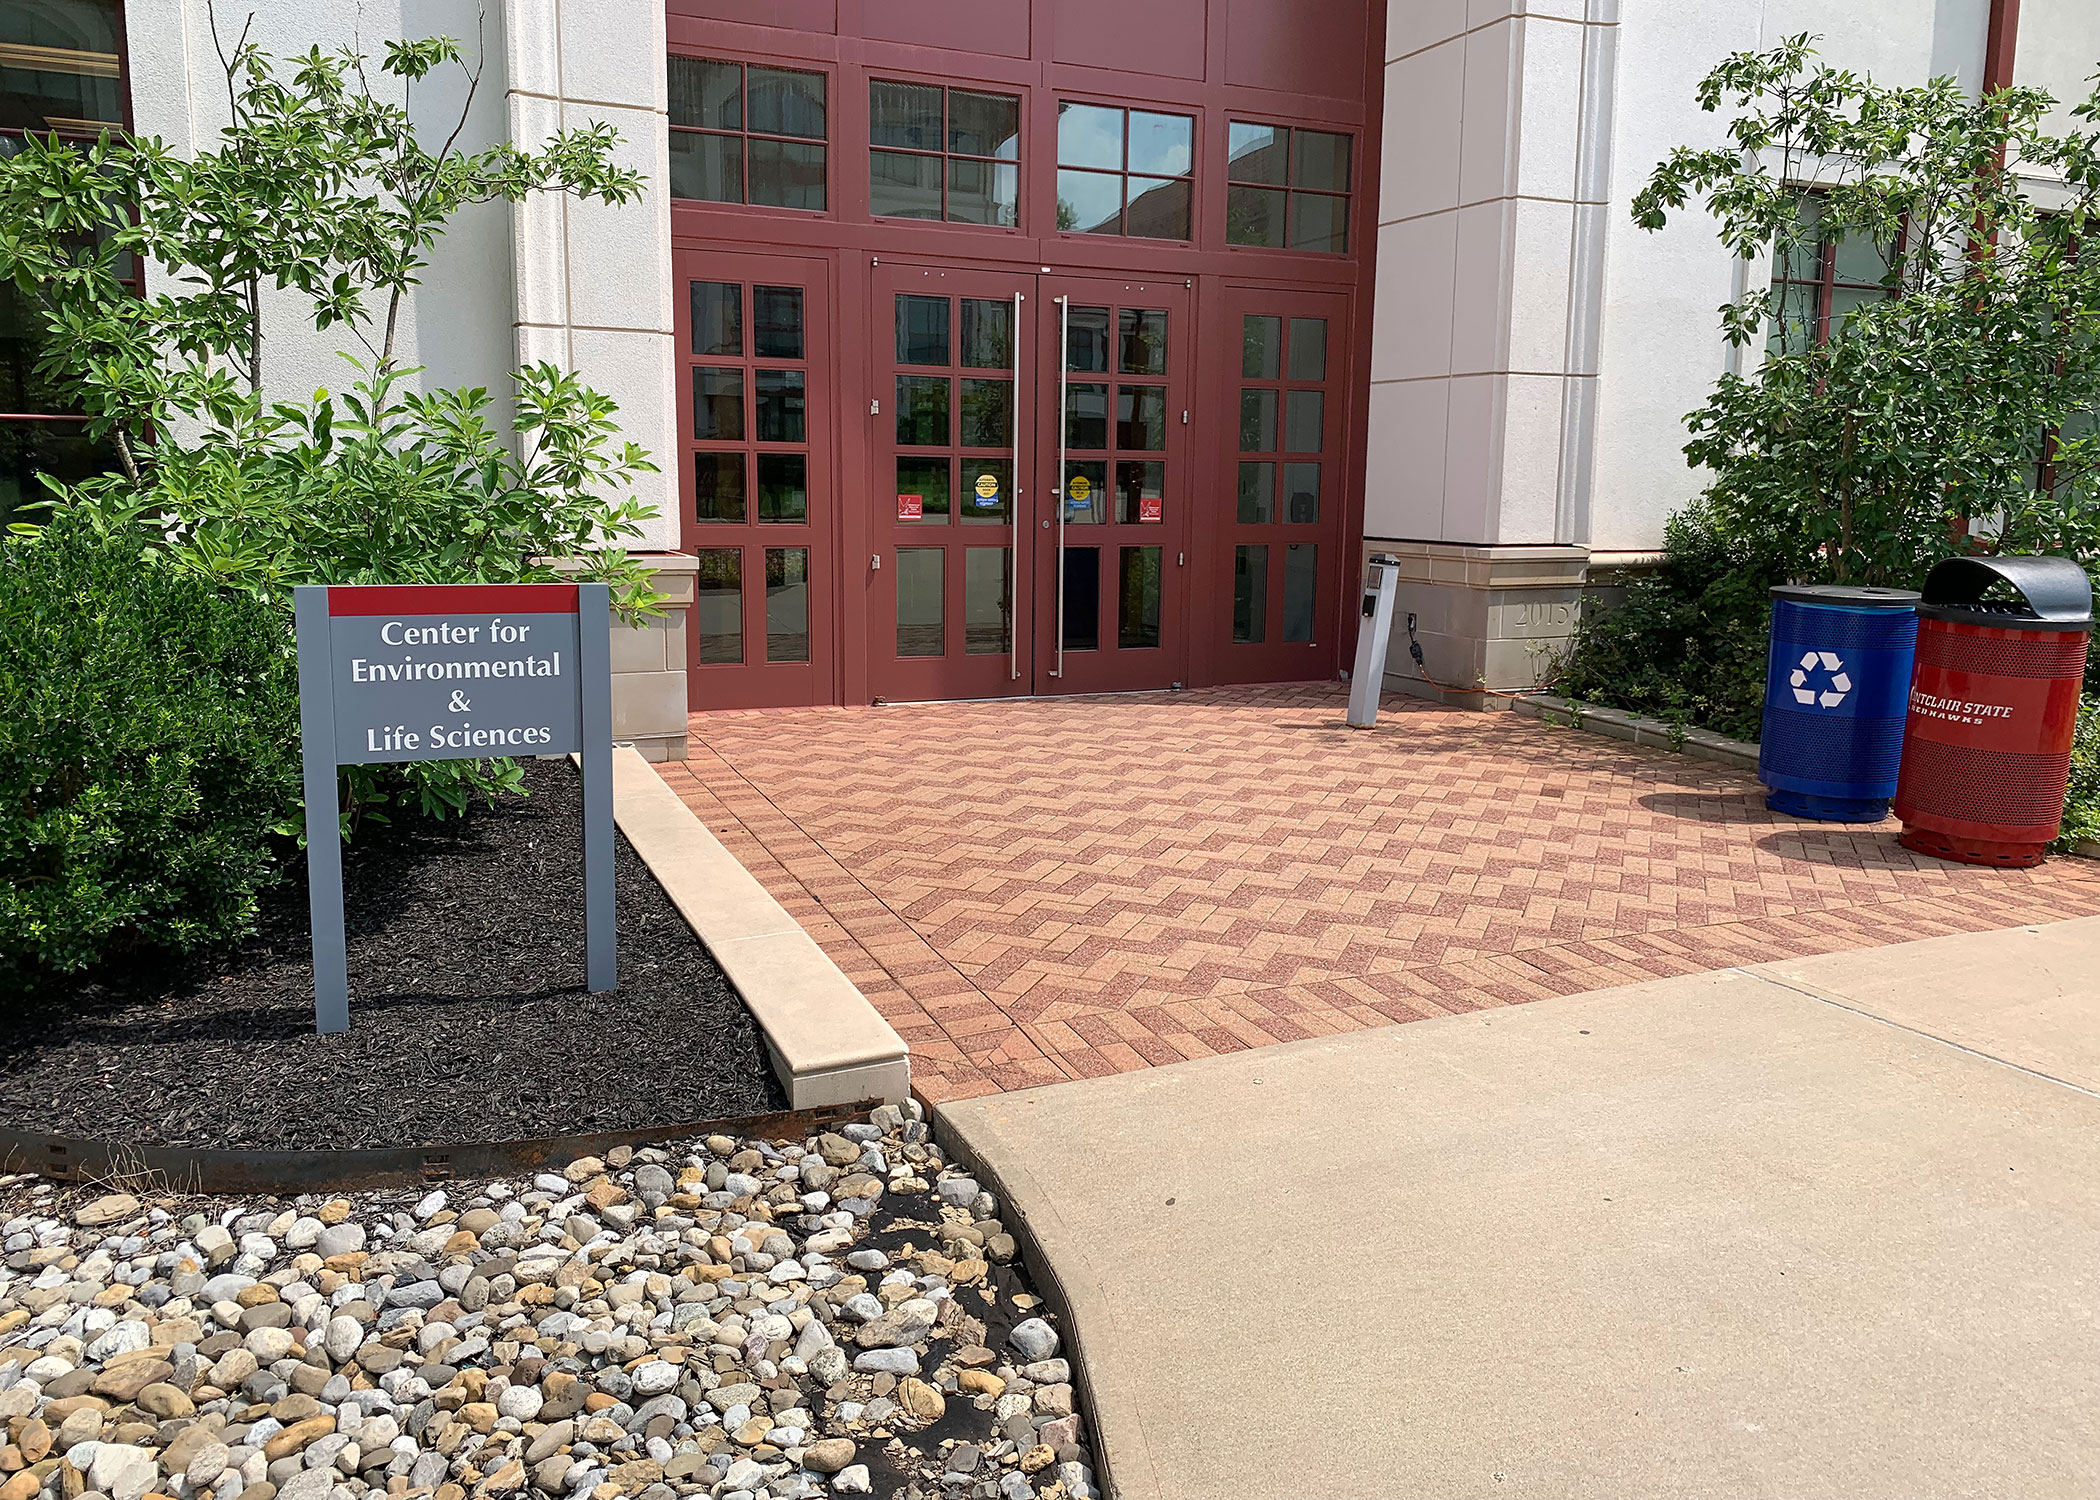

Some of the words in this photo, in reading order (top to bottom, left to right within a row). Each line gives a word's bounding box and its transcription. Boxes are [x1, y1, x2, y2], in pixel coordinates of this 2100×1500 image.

[1515, 600, 1569, 626] 2015
[380, 621, 480, 646] Center
[489, 618, 530, 643] for
[352, 651, 561, 682] Environmental
[448, 689, 472, 713] &
[1962, 702, 2014, 719] STATE
[367, 726, 420, 752] Life
[430, 722, 551, 749] Sciences
